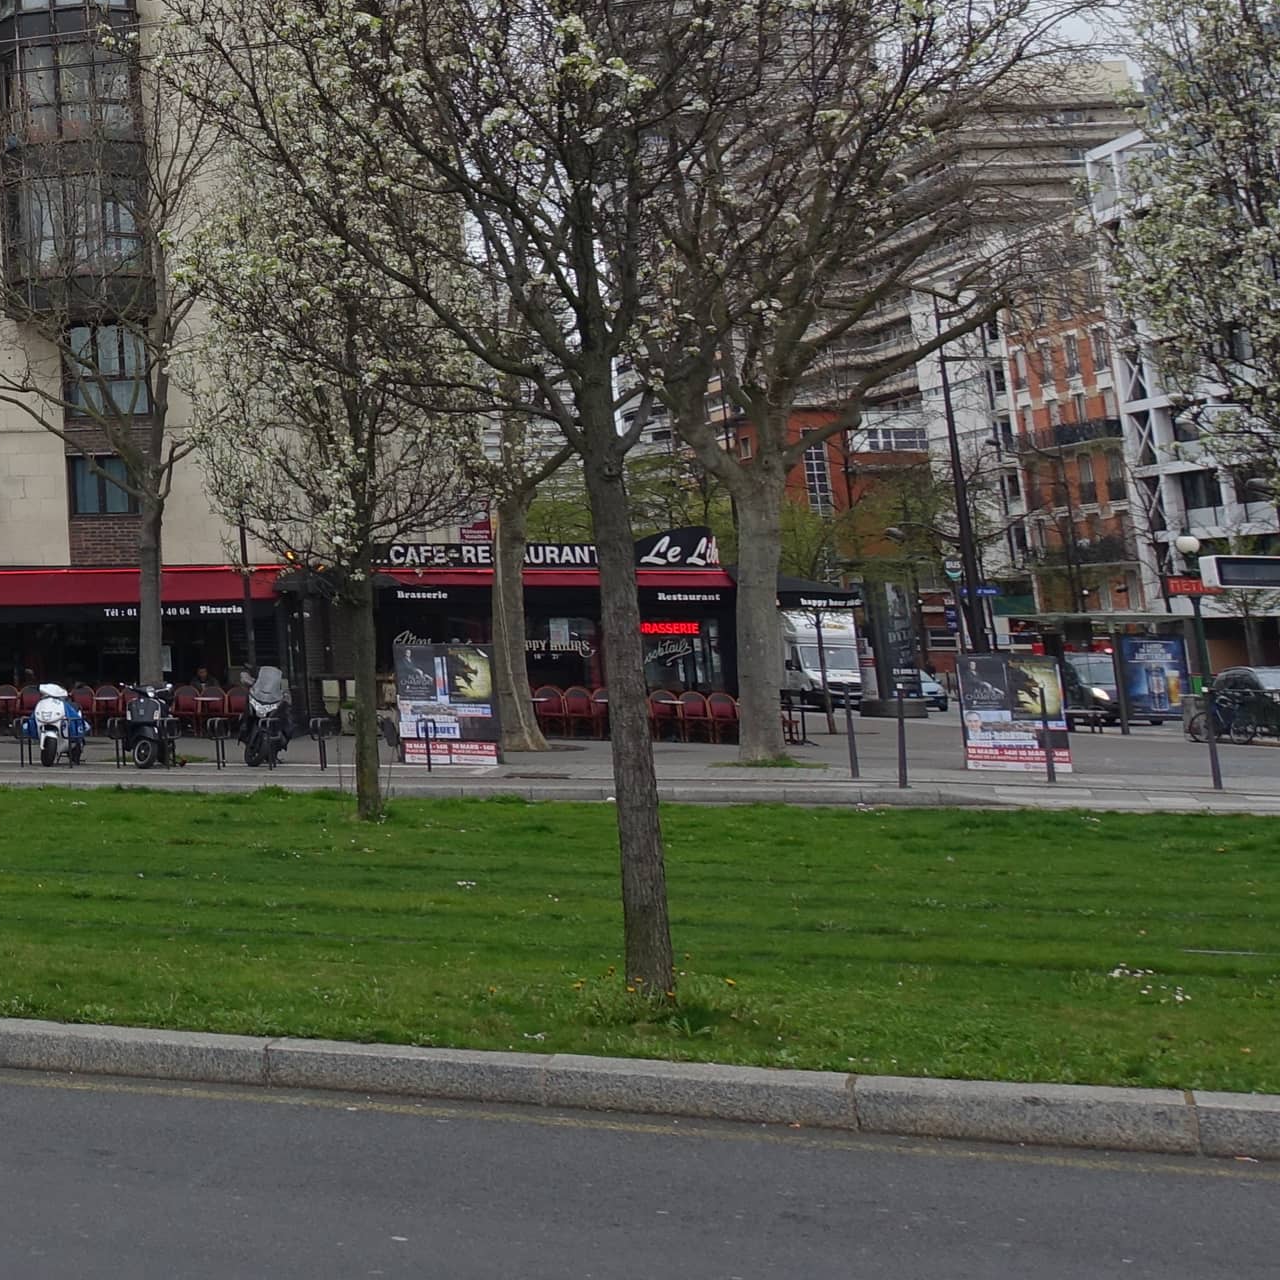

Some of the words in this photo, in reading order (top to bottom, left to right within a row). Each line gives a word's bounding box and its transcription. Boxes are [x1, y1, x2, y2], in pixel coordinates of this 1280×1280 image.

[640, 535, 681, 565] Le
[397, 591, 448, 599] Brasserie
[657, 592, 721, 600] Restaurant
[104, 608, 119, 617] Tél
[199, 605, 243, 614] Pizzeria
